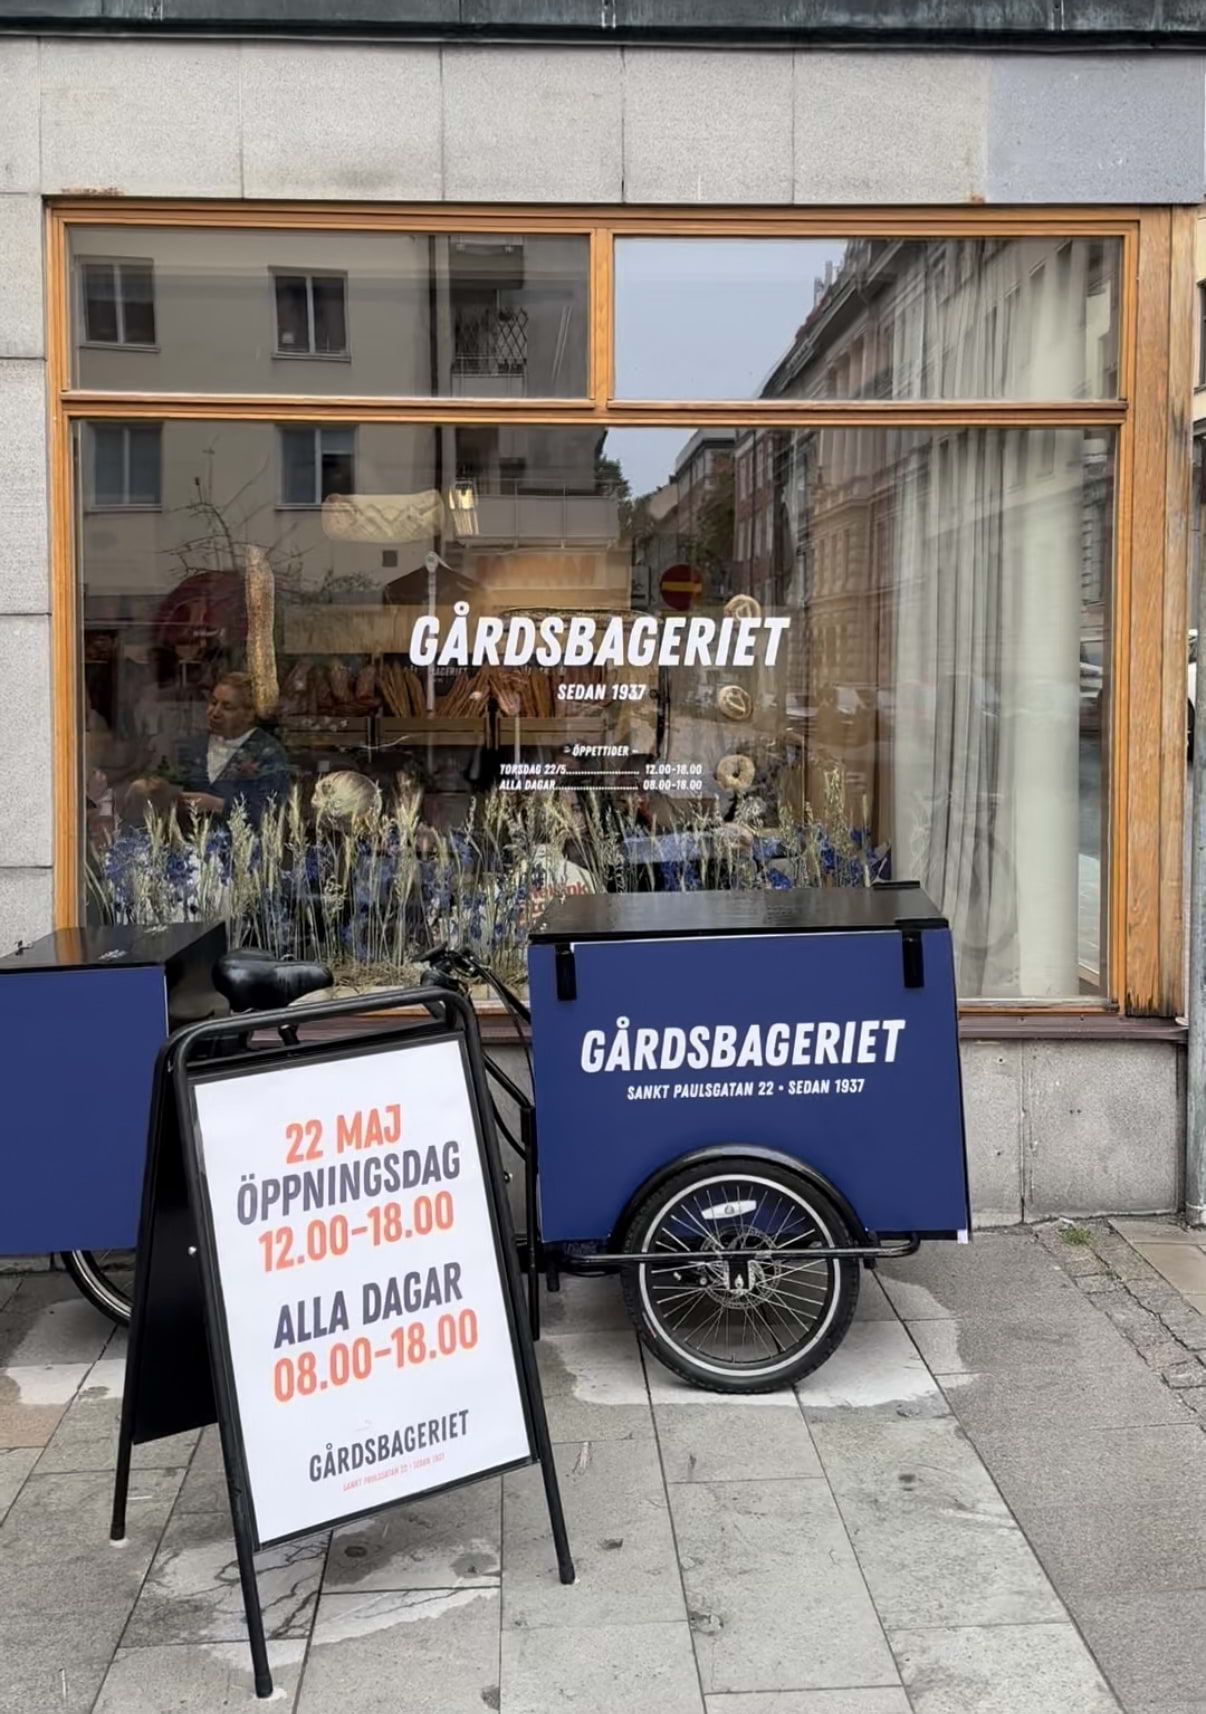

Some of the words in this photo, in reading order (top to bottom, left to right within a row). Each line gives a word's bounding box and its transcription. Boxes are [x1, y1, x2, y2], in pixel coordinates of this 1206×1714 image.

[409, 601, 791, 666] GÅRDSBAGERIET
[557, 684, 605, 701] SEDAN
[611, 684, 646, 701] 1937
[500, 764, 542, 775] TORSDAG
[572, 744, 629, 757] ÖPPETTIDER
[499, 780, 521, 791] ALLA
[525, 780, 555, 791] DAGAR
[580, 1016, 906, 1073] GÅRDSBAGERIET
[627, 1084, 670, 1101] SANKT
[673, 1082, 754, 1099] PAULSGATAN
[758, 1081, 774, 1096] 22
[788, 1079, 830, 1095] SEDAN
[835, 1078, 865, 1094] 1937
[285, 1120, 324, 1165] 22
[336, 1104, 402, 1154] MAJ
[237, 1140, 461, 1226] ÖPPNINGSDAG
[258, 1190, 455, 1273] 12.00-18.00
[273, 1289, 350, 1350] ALLA
[362, 1261, 463, 1326] DAGAR
[273, 1309, 479, 1402] 08.00-18.00
[309, 1409, 470, 1483] GÅRDSBAGERIET
